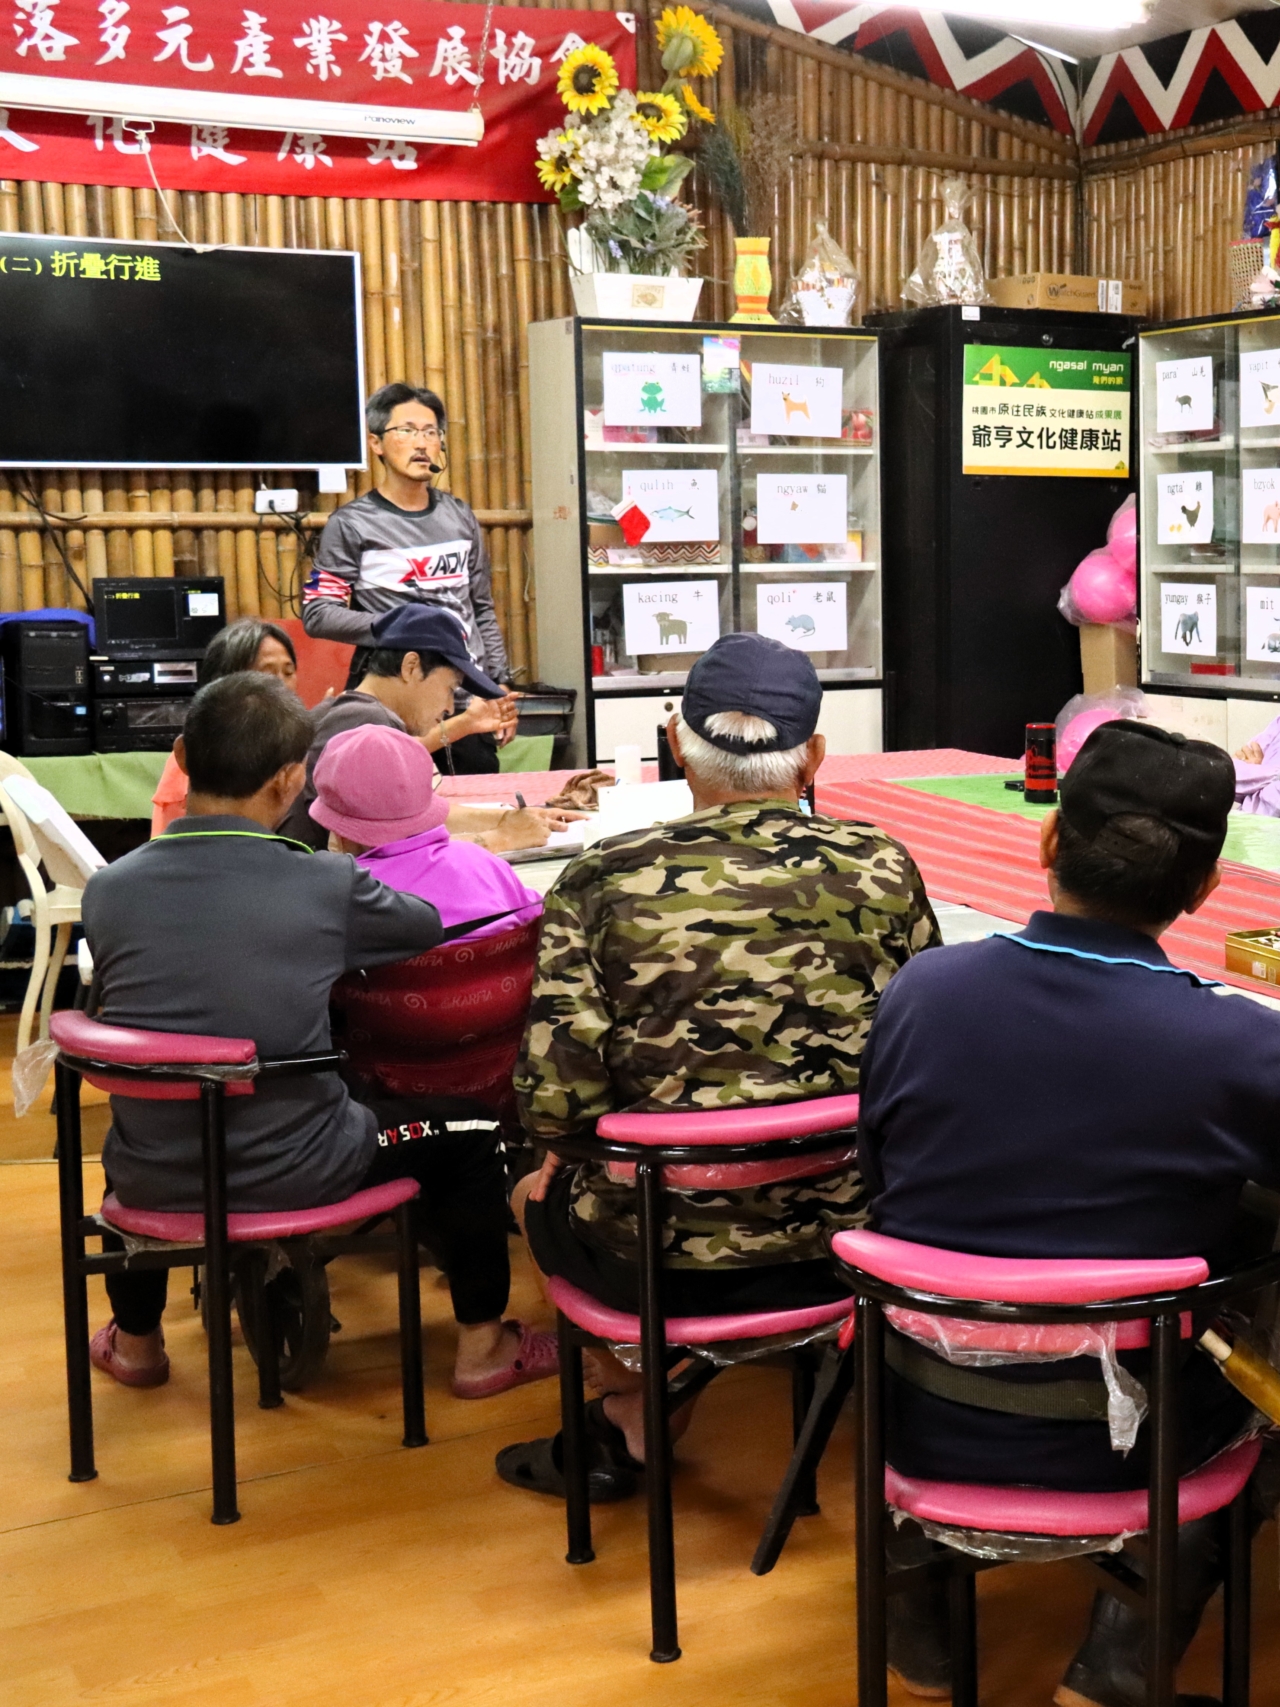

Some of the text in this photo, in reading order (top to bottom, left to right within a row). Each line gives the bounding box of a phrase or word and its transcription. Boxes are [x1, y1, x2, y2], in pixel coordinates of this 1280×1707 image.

[1049, 360, 1124, 374] ngasal myan
[768, 373, 800, 386] huzil
[1092, 376, 1124, 385] 我們的家
[972, 425, 1122, 452] 爺亨文化健康站
[640, 478, 674, 490] qulih
[777, 483, 827, 495] ngyaw 貓
[637, 589, 704, 604] kacing 牛
[813, 591, 836, 603] 老鼠
[1165, 593, 1188, 606] yungay
[1260, 597, 1274, 610] mit
